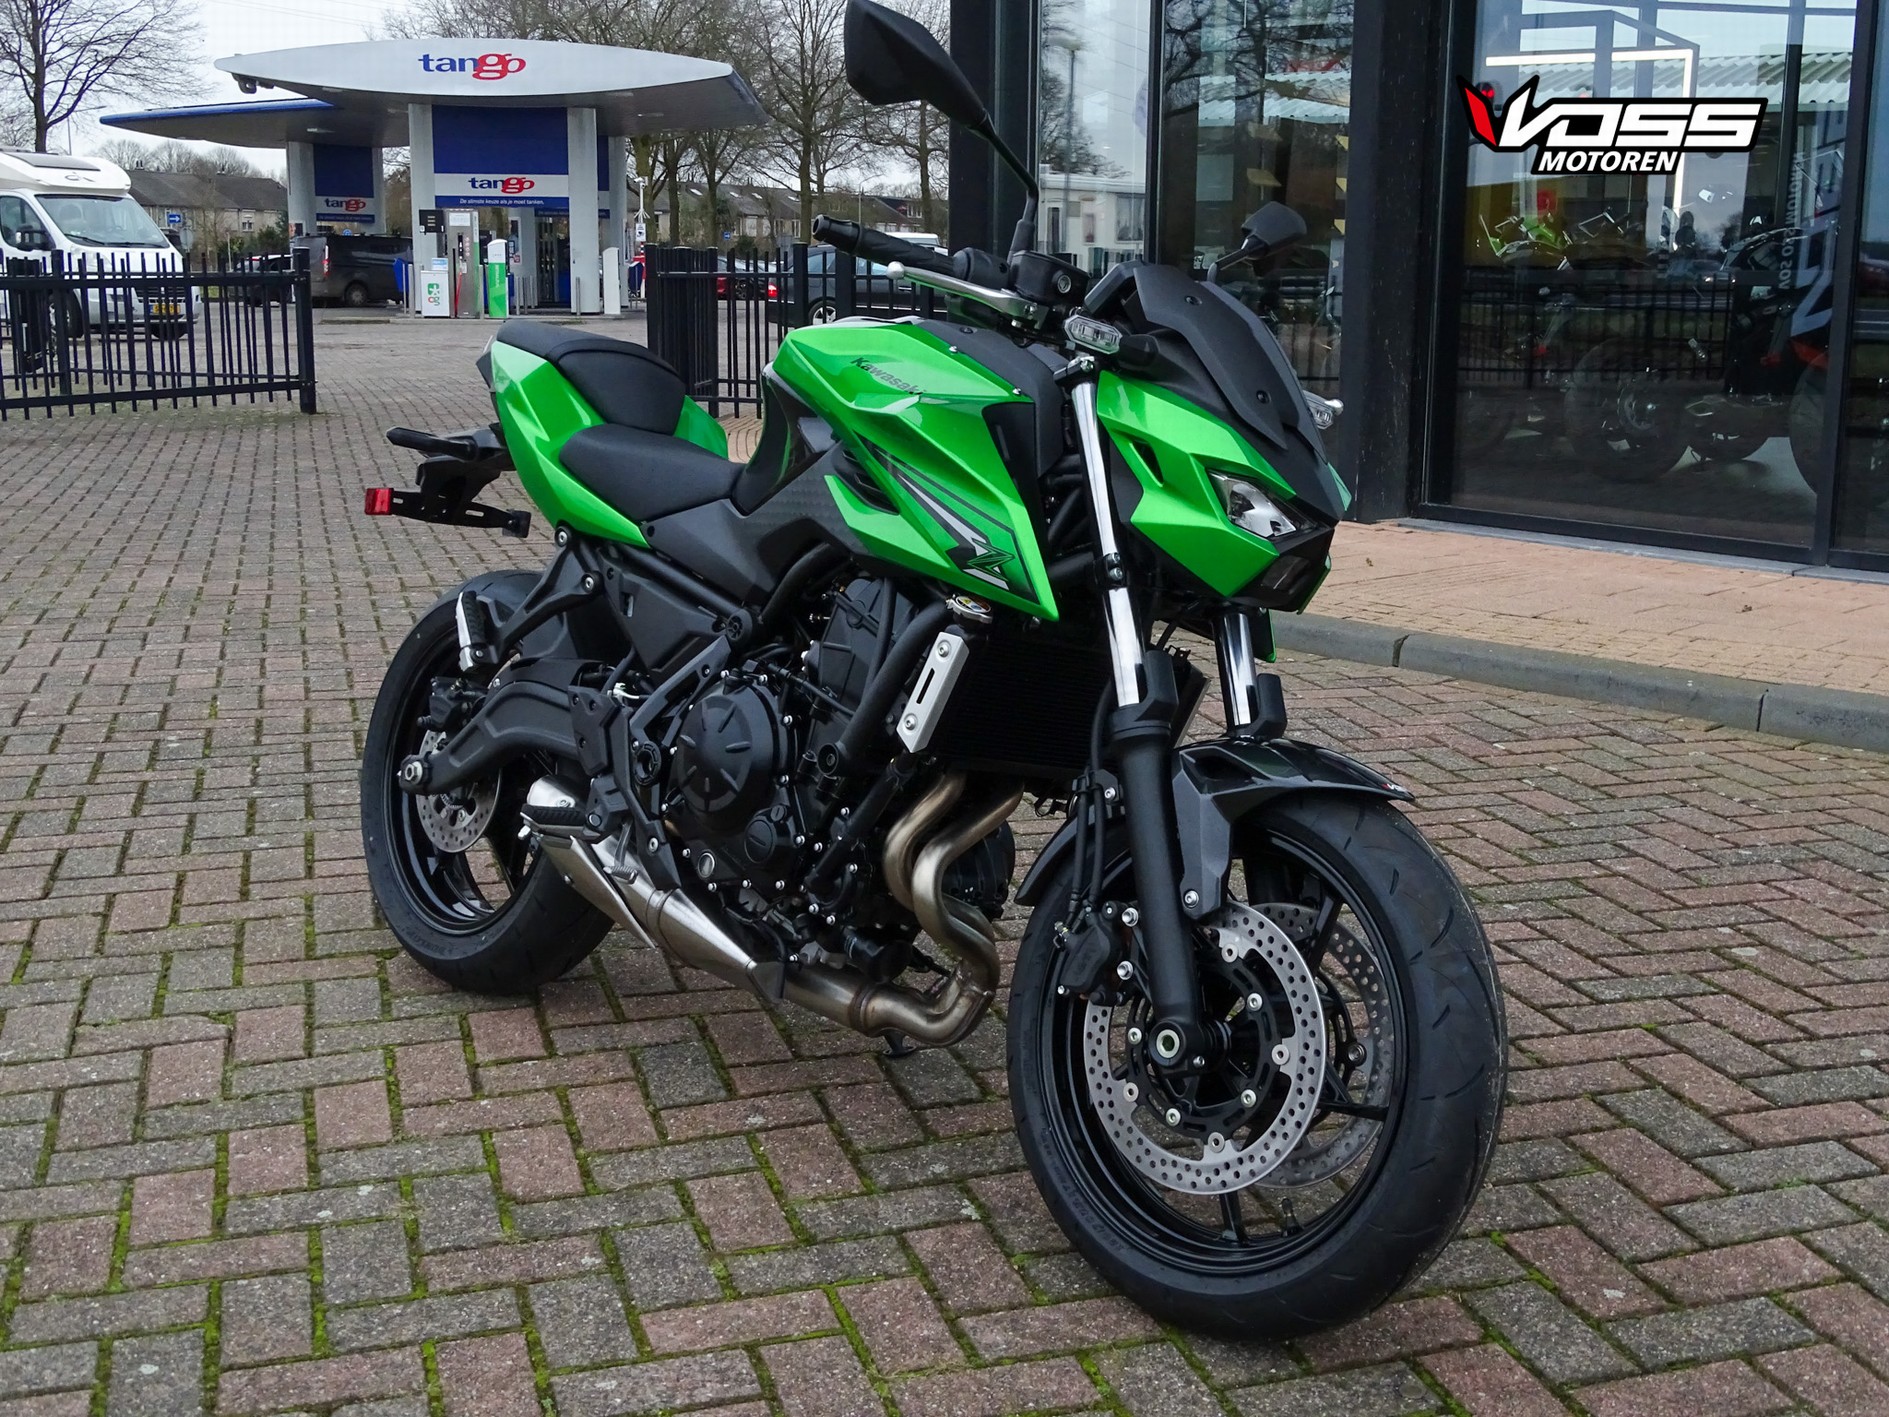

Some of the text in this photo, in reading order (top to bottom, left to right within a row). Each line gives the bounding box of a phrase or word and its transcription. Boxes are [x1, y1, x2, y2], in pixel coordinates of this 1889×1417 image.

[418, 53, 527, 81] tango
[468, 176, 535, 194] tango
[324, 198, 367, 212] tango
[851, 357, 927, 396] Kawasaki
